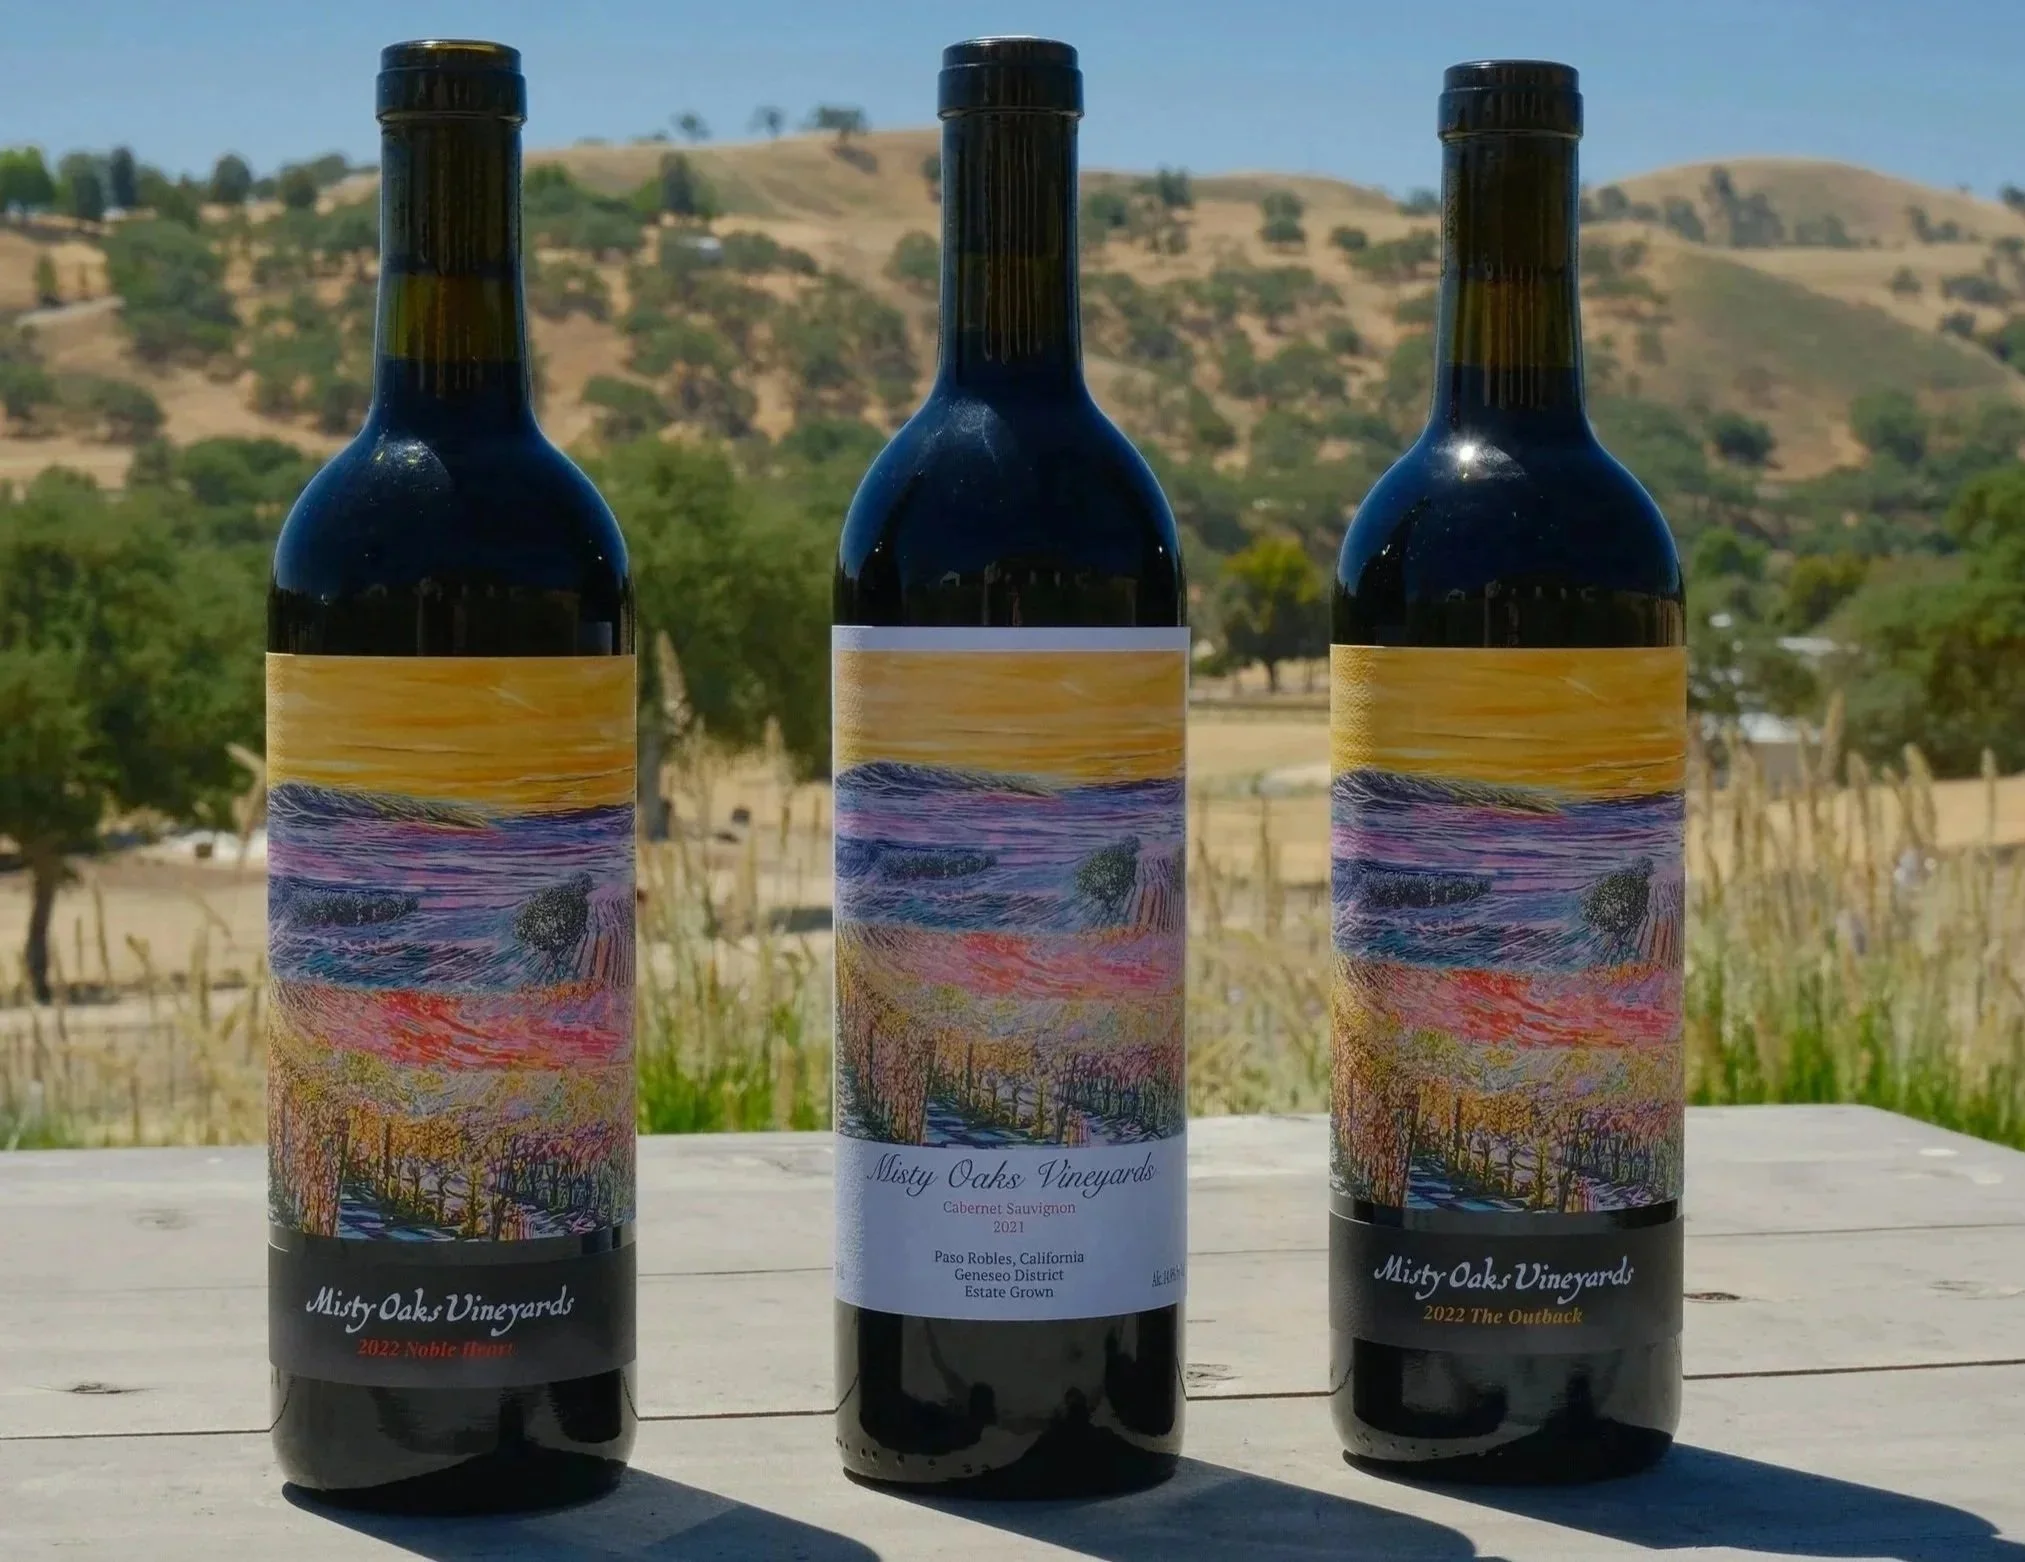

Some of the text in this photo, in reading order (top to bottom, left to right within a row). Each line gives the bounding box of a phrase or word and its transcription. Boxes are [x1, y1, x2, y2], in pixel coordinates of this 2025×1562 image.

[867, 1151, 1157, 1199] Misty Oaks Vineyards
[943, 1201, 1077, 1217] Cabernet Sauvignon
[993, 1221, 1025, 1234] 2021
[934, 1250, 1085, 1267] Paso Robles, California
[954, 1268, 1065, 1282] Geneseo District
[1374, 1255, 1635, 1305] Misty Oaks Vineyards
[964, 1285, 1055, 1299] Estate Grown
[306, 1285, 575, 1337] Misty Oaks Vineyards
[1423, 1305, 1584, 1326] 2022 The Outback
[357, 1339, 400, 1357] 2022
[404, 1341, 457, 1359] Noble
